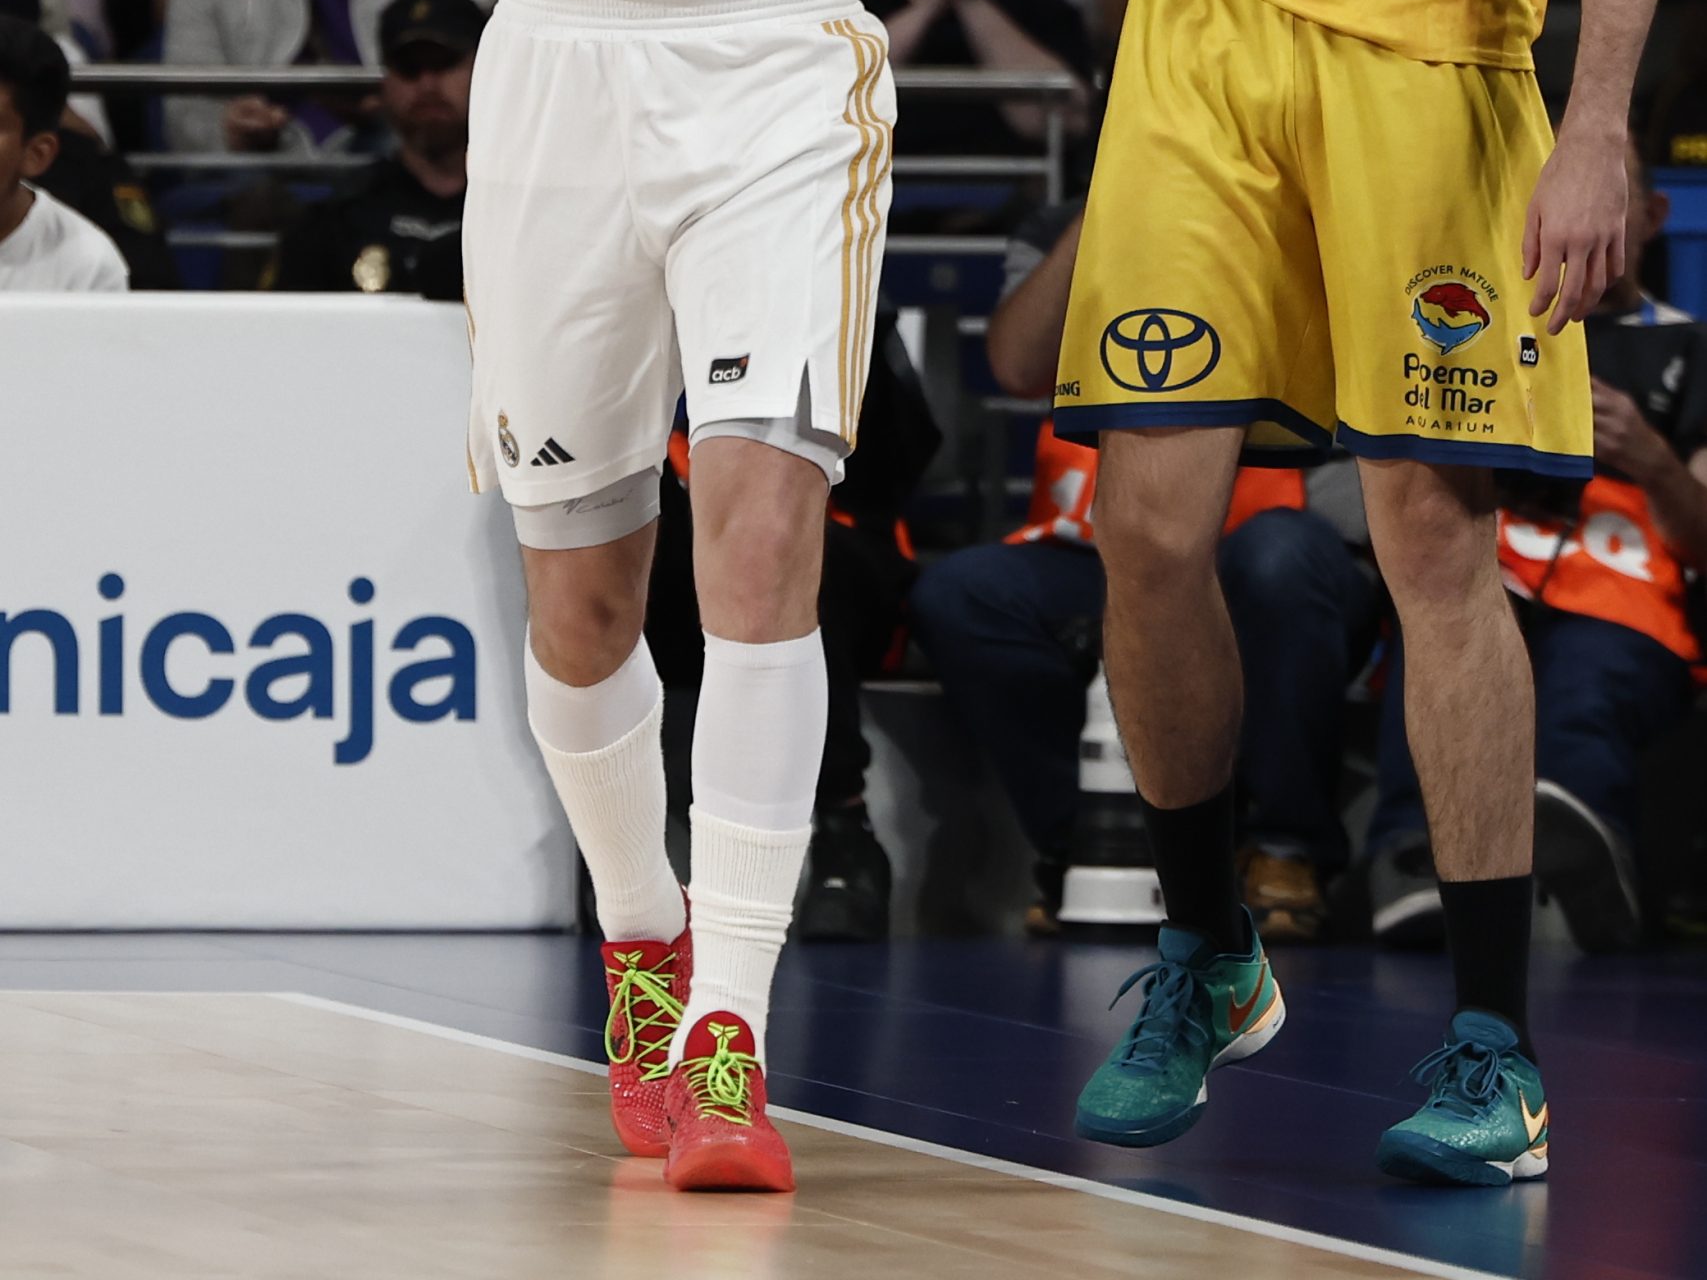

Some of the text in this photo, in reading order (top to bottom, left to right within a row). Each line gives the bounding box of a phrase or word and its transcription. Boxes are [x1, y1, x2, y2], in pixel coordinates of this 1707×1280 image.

[1405, 265, 1500, 302] DISCOVER NATURE
[711, 366, 741, 382] acb
[1404, 352, 1498, 387] Poema
[1441, 388, 1496, 414] Mar
[0, 572, 478, 766] nicaja
